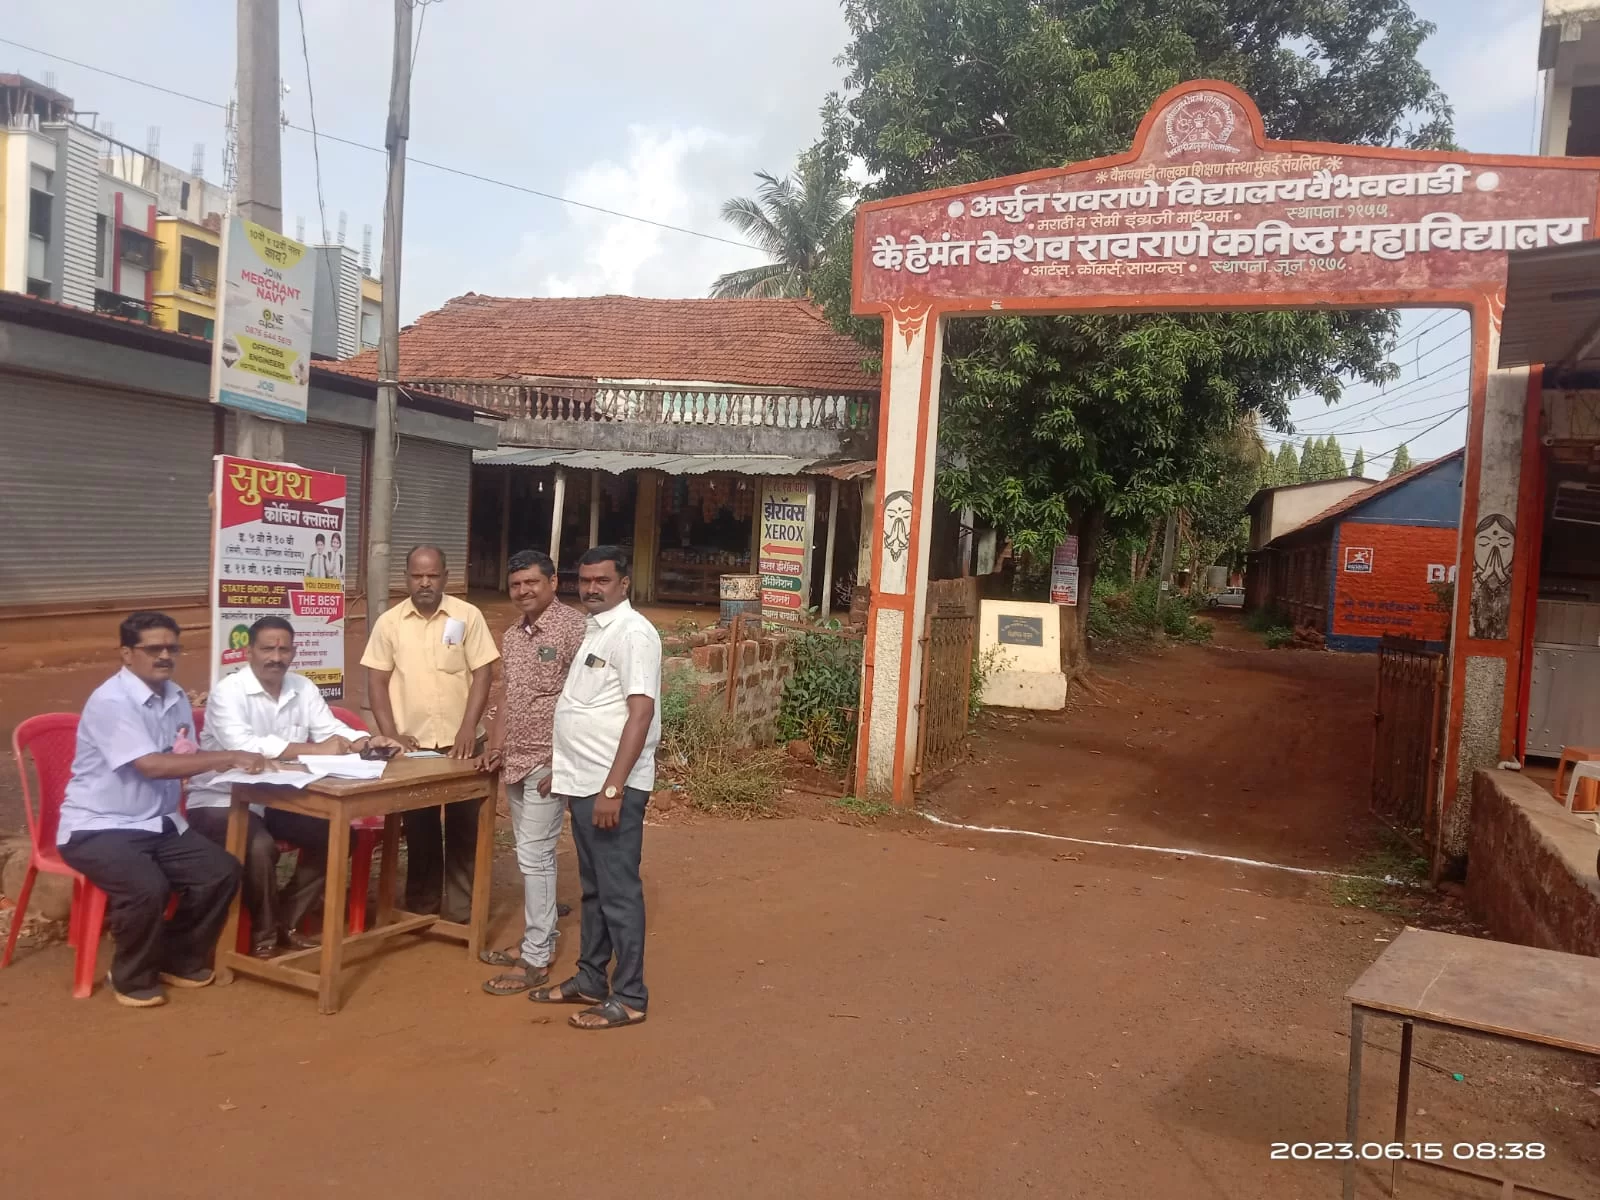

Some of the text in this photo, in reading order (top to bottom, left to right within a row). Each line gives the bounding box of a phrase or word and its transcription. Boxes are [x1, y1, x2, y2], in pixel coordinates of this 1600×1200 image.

[1157, 165, 1192, 182] तालुका
[1192, 161, 1226, 177] शिक्षण
[1226, 159, 1254, 176] संस्था
[1254, 155, 1281, 178] मुंबई
[970, 185, 1050, 223] अर्जुन
[1051, 180, 1164, 213] रावराणे
[1037, 213, 1076, 232] मराठी
[1077, 216, 1088, 229] व
[1090, 212, 1122, 230] सेमी
[1176, 209, 1233, 224] माध्यम
[906, 232, 976, 274] हेमंत
[975, 230, 1076, 263] केशव
[1077, 221, 1214, 262] रावराणे
[1213, 219, 1339, 257] कनिष्ठ
[1339, 212, 1589, 260] महाविद्यालय
[264, 246, 288, 265] काय?
[263, 267, 282, 281] JOIN
[241, 269, 301, 300] MERCHANT
[256, 286, 286, 306] NAVY
[251, 342, 284, 358] OFFICERS
[248, 353, 286, 370] ENGINEERS
[227, 463, 313, 506] सुयश
[263, 502, 339, 530] कोचिंग क्लासेस
[763, 495, 806, 522] झेरॉक्स
[764, 523, 805, 542] XEROX
[221, 583, 246, 593] STATE
[305, 580, 341, 591] YOU DESERVE
[250, 596, 282, 605] MHT-CET
[297, 594, 341, 607] THE BEST
[301, 606, 338, 616] EDUCATION
